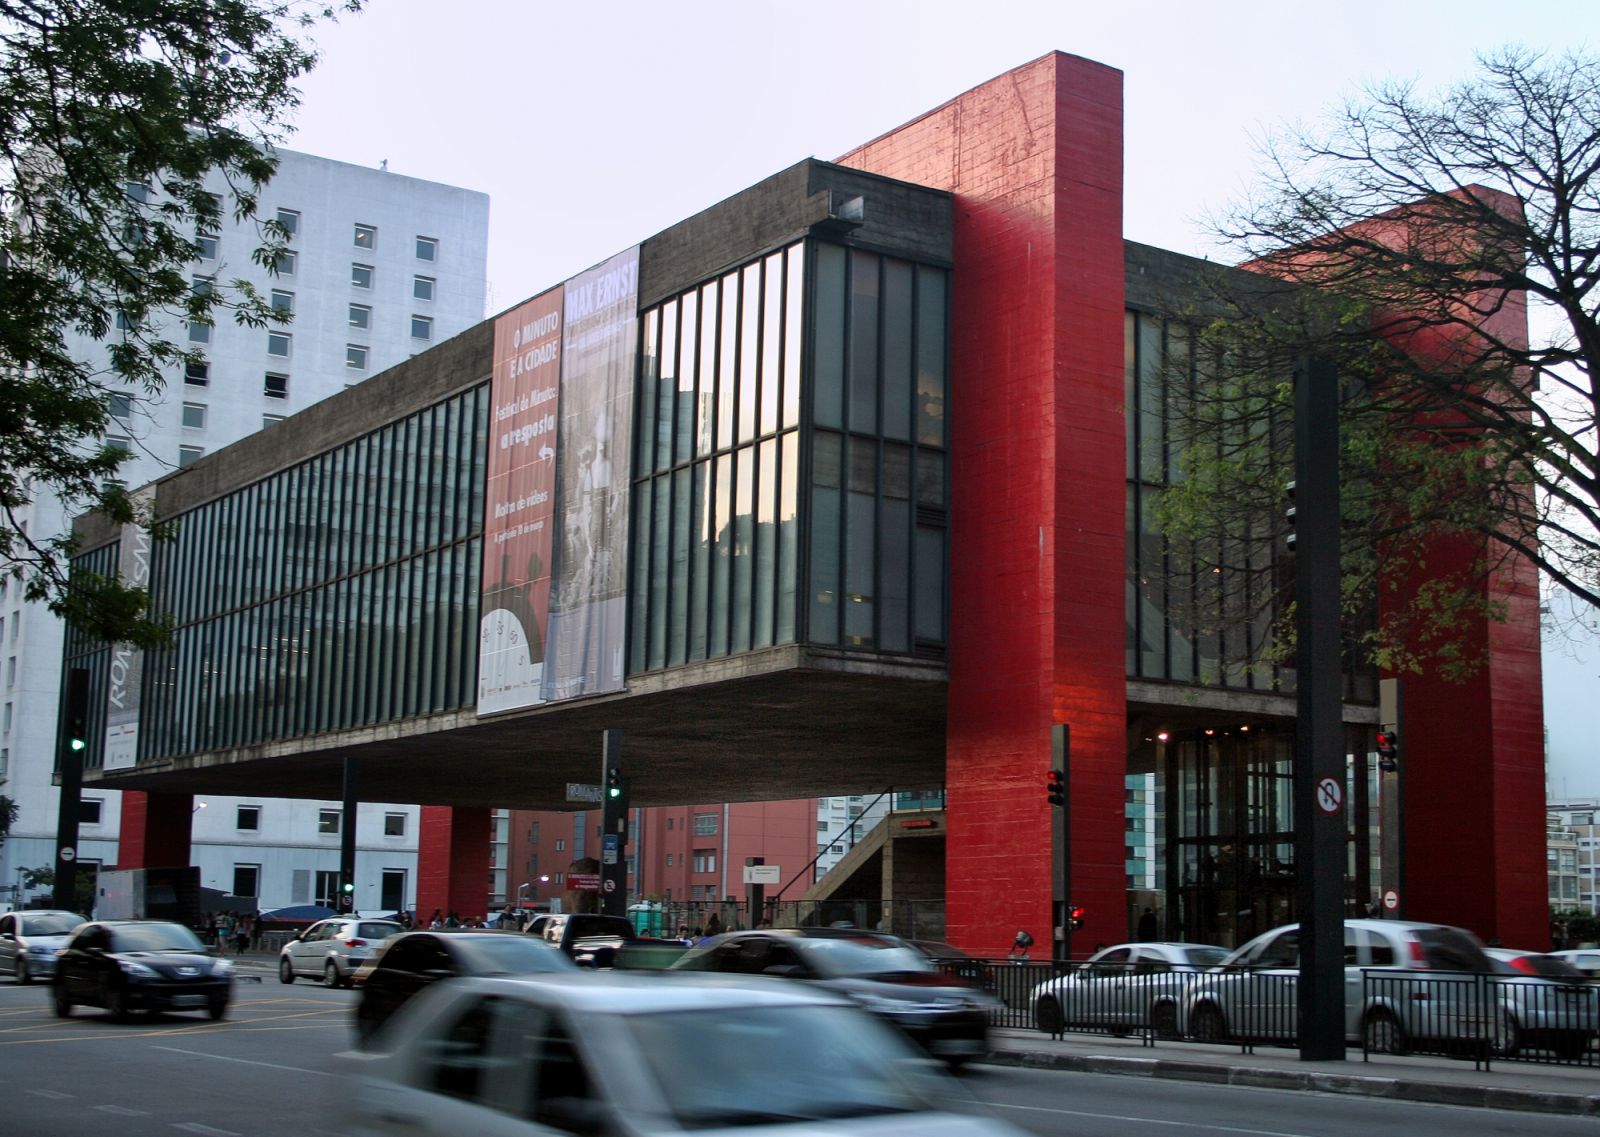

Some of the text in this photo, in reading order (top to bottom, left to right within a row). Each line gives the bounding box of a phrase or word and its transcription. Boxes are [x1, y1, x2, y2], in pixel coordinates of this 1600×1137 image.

[565, 283, 593, 324] MAX
[596, 260, 637, 311] ERNST
[513, 329, 521, 348] O
[521, 311, 558, 346] MINUTO
[510, 340, 557, 378] E A CIDADE
[501, 413, 554, 449] a resposta
